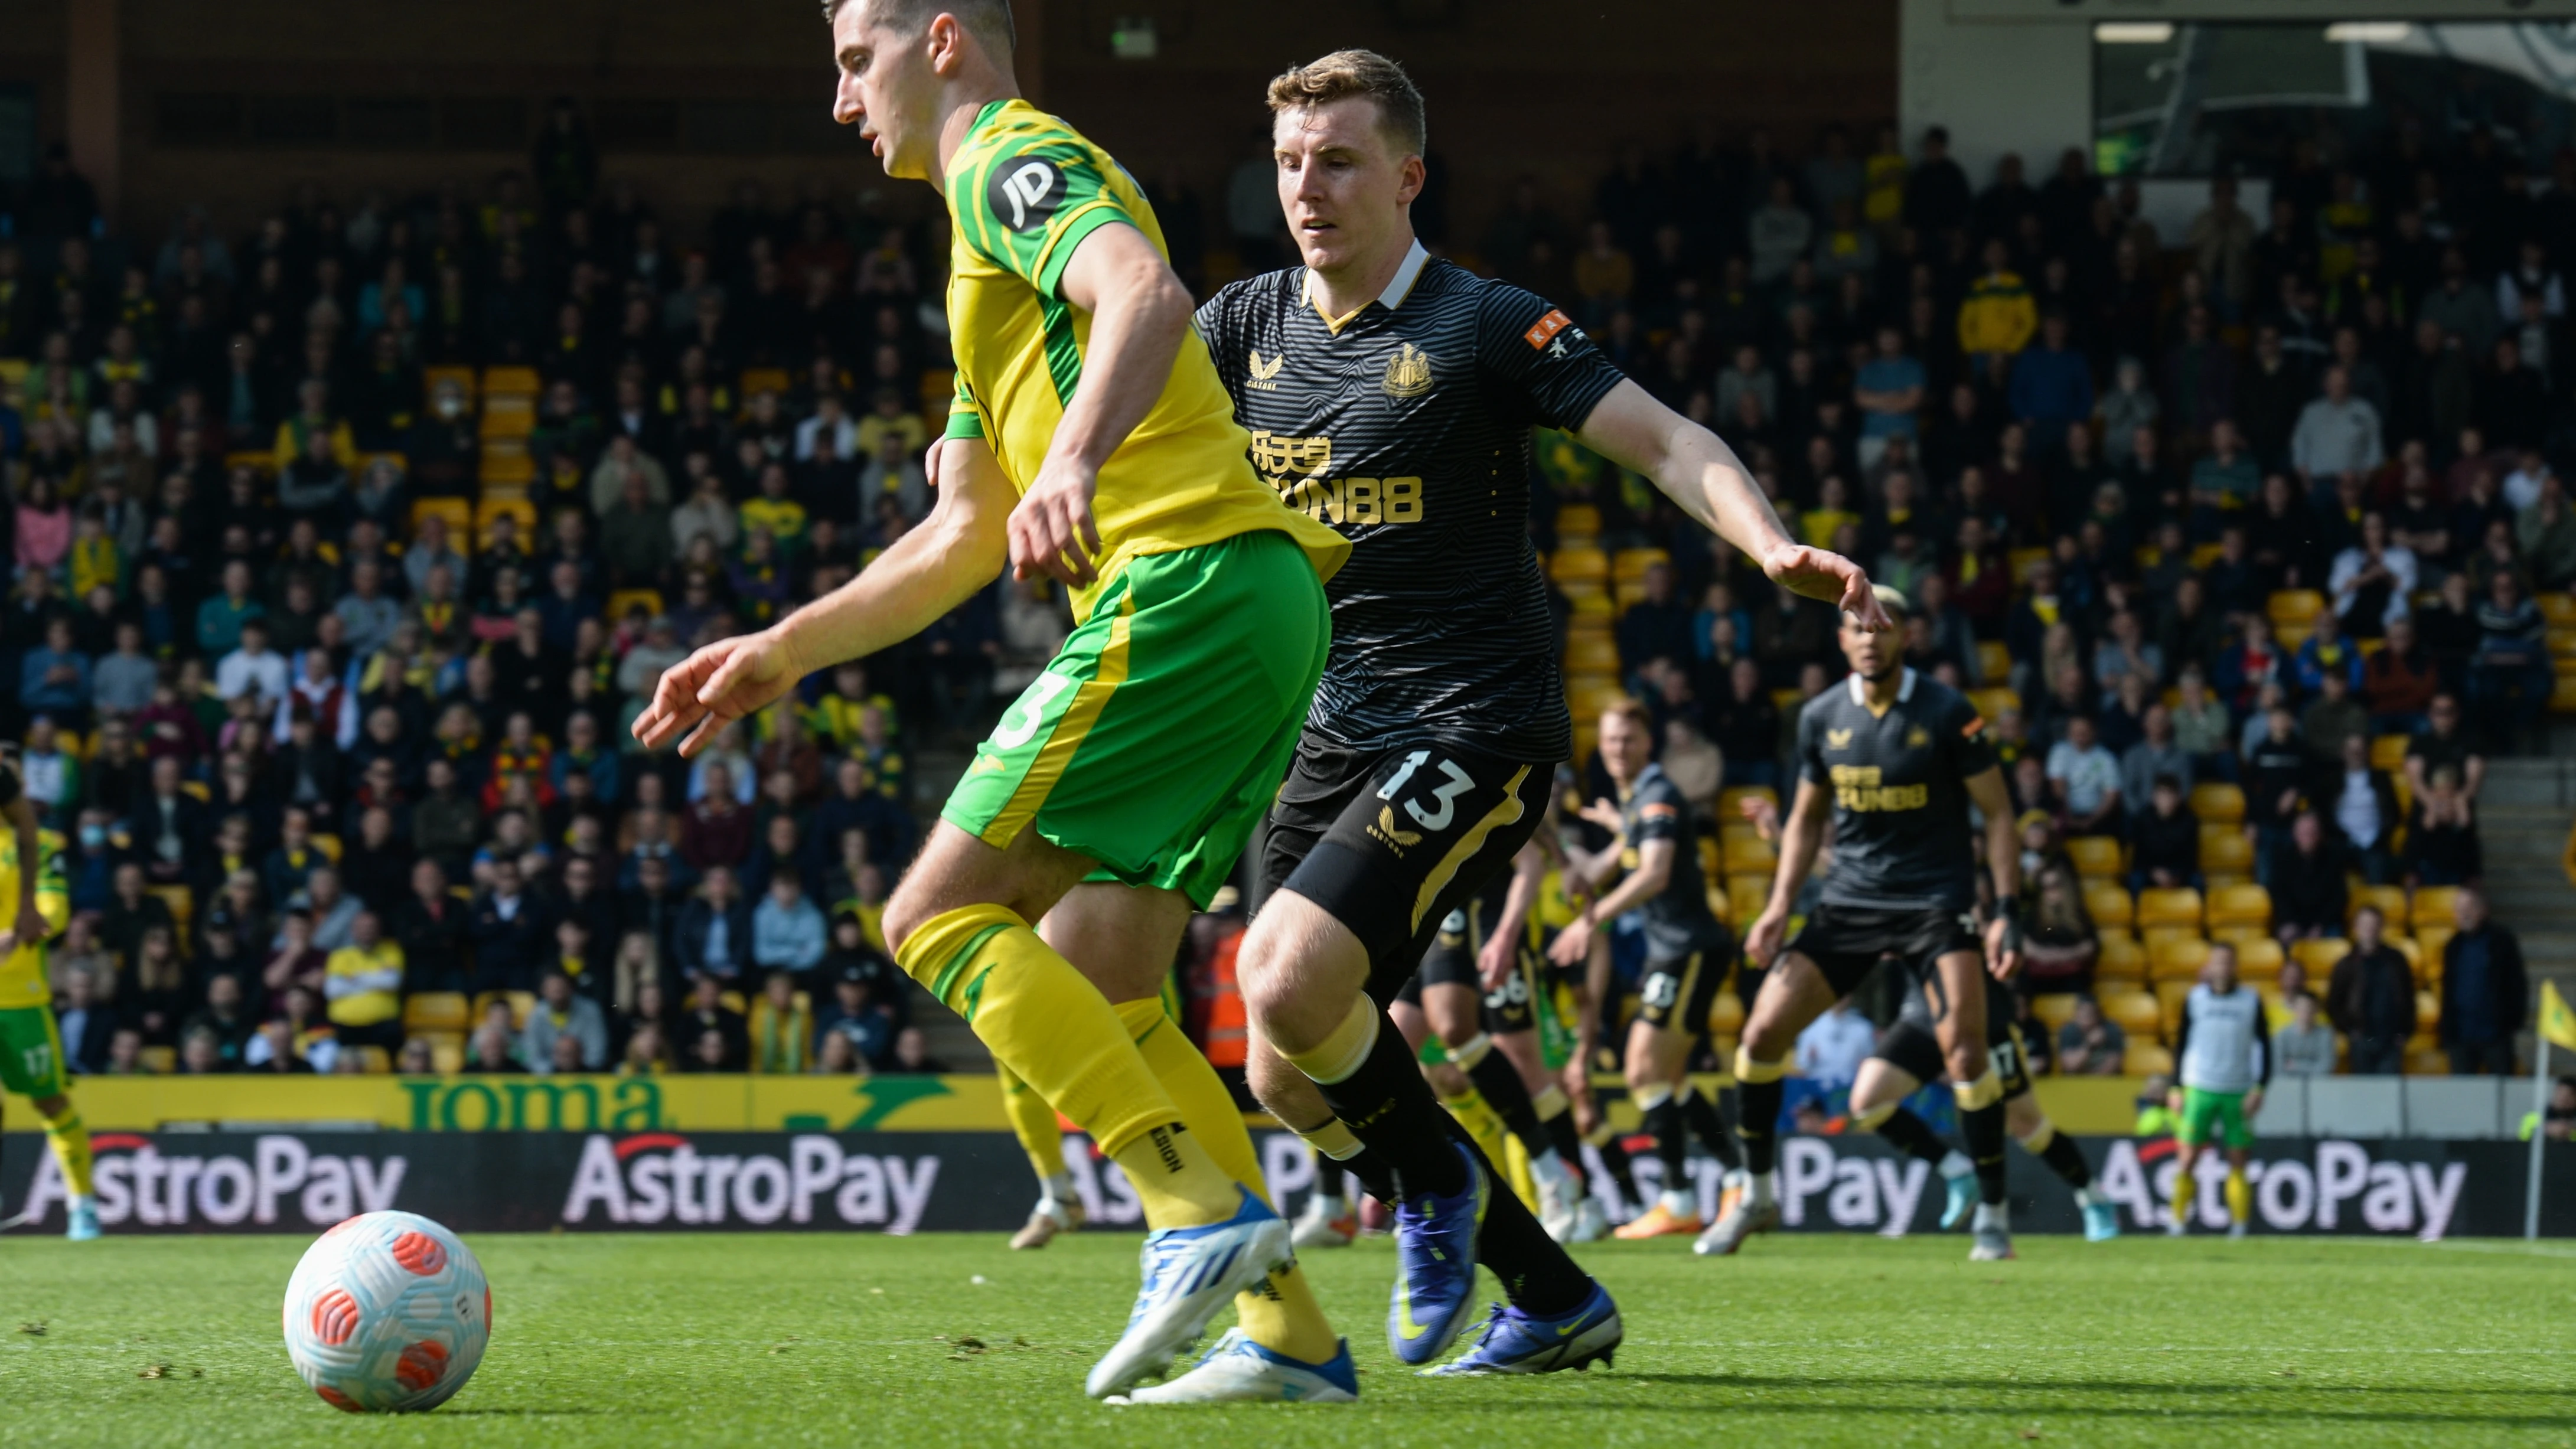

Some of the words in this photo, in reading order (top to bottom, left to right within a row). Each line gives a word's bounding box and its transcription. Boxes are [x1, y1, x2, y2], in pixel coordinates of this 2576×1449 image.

[1002, 162, 1054, 229] JD
[1377, 750, 1476, 831] 13
[562, 1134, 940, 1235] AstroPay
